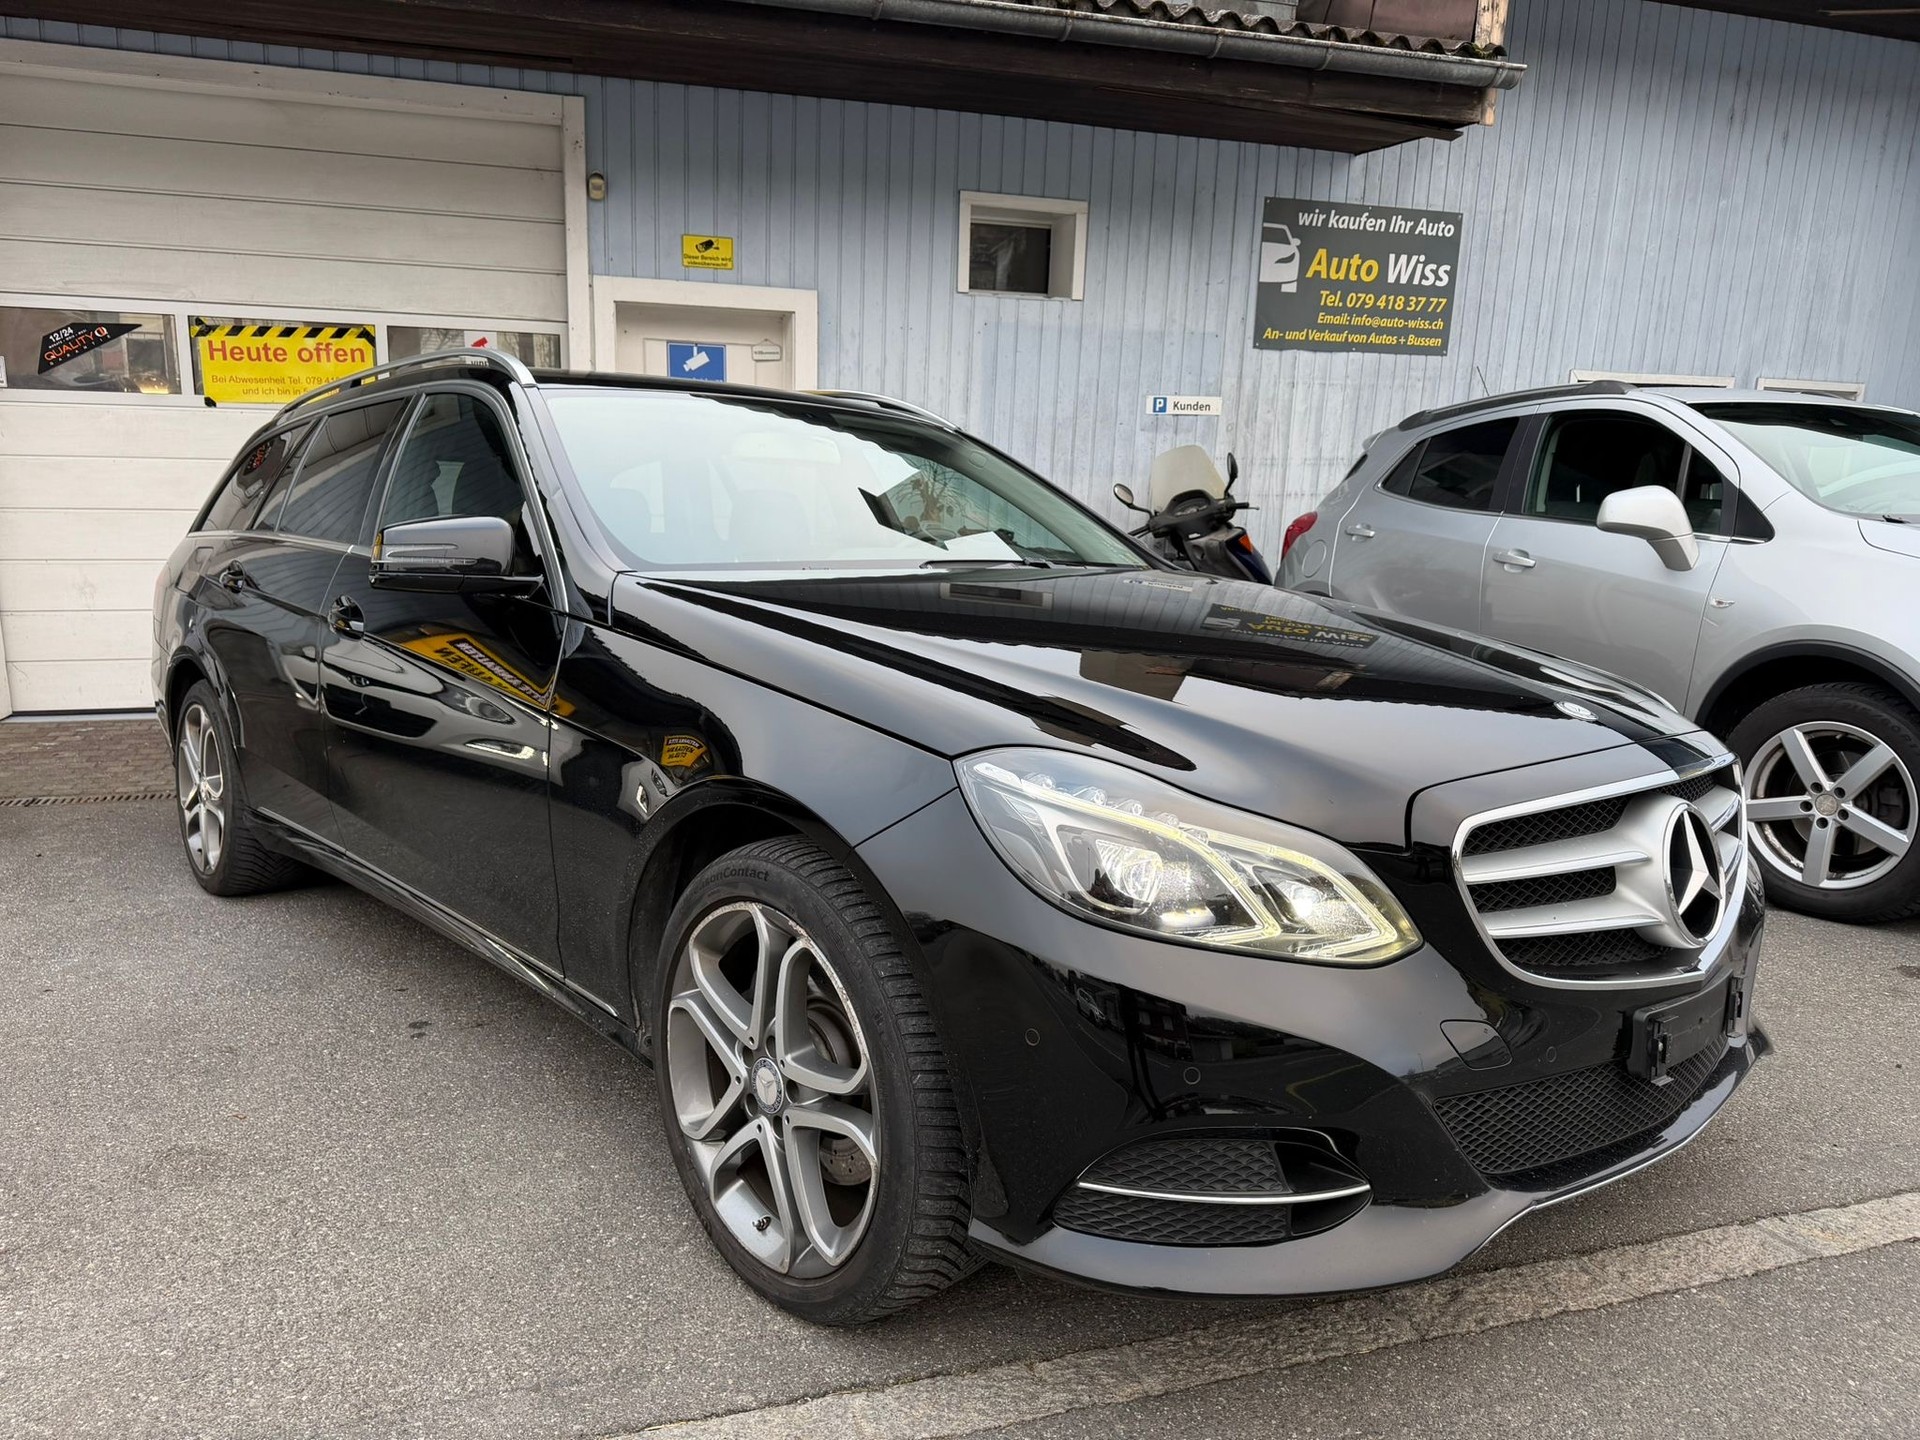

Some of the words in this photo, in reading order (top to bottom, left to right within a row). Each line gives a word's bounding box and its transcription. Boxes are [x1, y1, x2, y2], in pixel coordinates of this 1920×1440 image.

[1298, 208, 1326, 227] wir
[1328, 209, 1386, 232] kaufen
[1389, 215, 1413, 234] Ihr
[1415, 217, 1455, 237] Auto
[1305, 248, 1379, 283] Auto
[1387, 253, 1451, 287] Wiss
[1319, 290, 1343, 308] Tel.
[1346, 293, 1375, 309] 079
[1377, 295, 1404, 311] 418
[1406, 297, 1426, 312] 37
[1427, 298, 1447, 313] 77
[1317, 312, 1350, 325] Email:
[1351, 314, 1444, 330] info@auto-wiss.ch
[48, 326, 74, 343] 12/24
[1263, 328, 1283, 340] An-
[1285, 329, 1307, 341] und
[1308, 329, 1347, 343] Verkauf
[1347, 334, 1367, 344] von
[1367, 333, 1397, 345] Autos
[1407, 335, 1442, 347] Bussen
[44, 331, 94, 361] QUALITY
[207, 340, 288, 364] Heute
[297, 341, 366, 364] offen
[211, 374, 227, 384] Bei
[229, 375, 286, 385] Abwesenheit
[288, 376, 302, 385] Tel.
[305, 376, 323, 385] 079
[242, 387, 259, 396] und
[261, 387, 275, 396] ich
[277, 387, 290, 396] bin
[292, 387, 301, 396] in
[1173, 401, 1211, 411] Kunden
